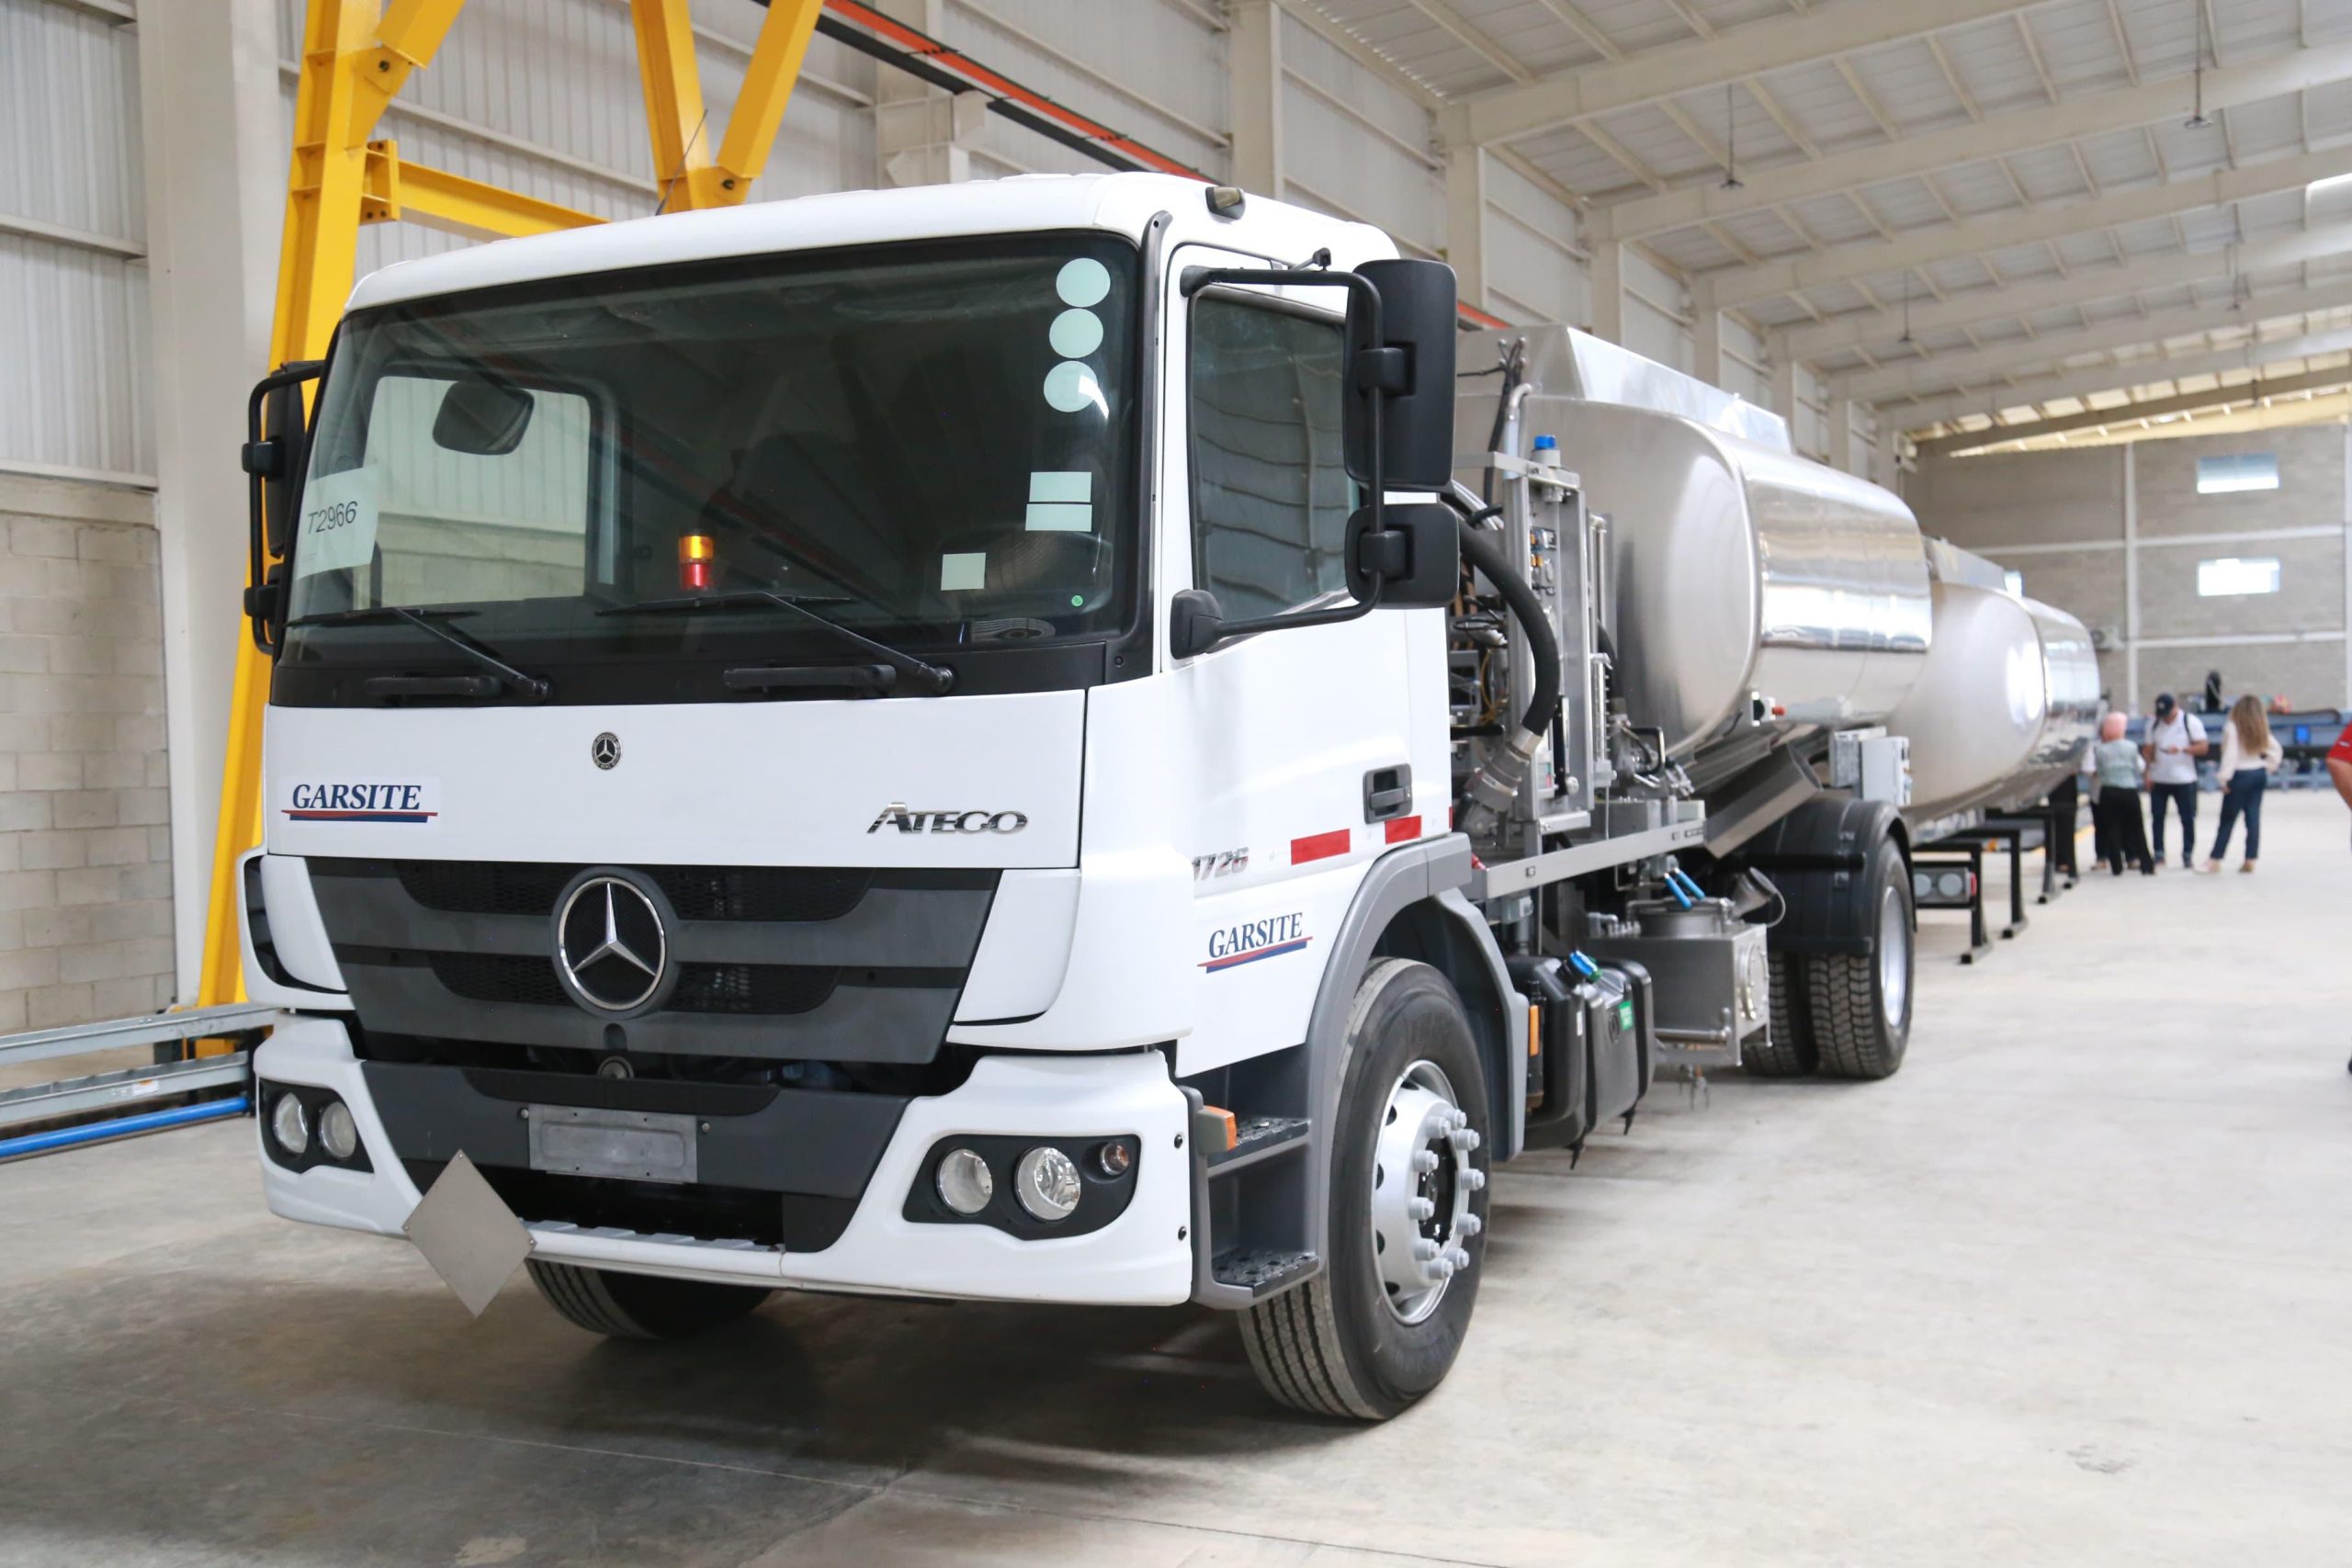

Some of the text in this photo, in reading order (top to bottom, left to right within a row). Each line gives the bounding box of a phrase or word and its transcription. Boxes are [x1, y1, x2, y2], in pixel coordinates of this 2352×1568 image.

[307, 502, 358, 534] T2966
[292, 784, 422, 810] GARSITE
[1208, 912, 1303, 958] GARSITE
